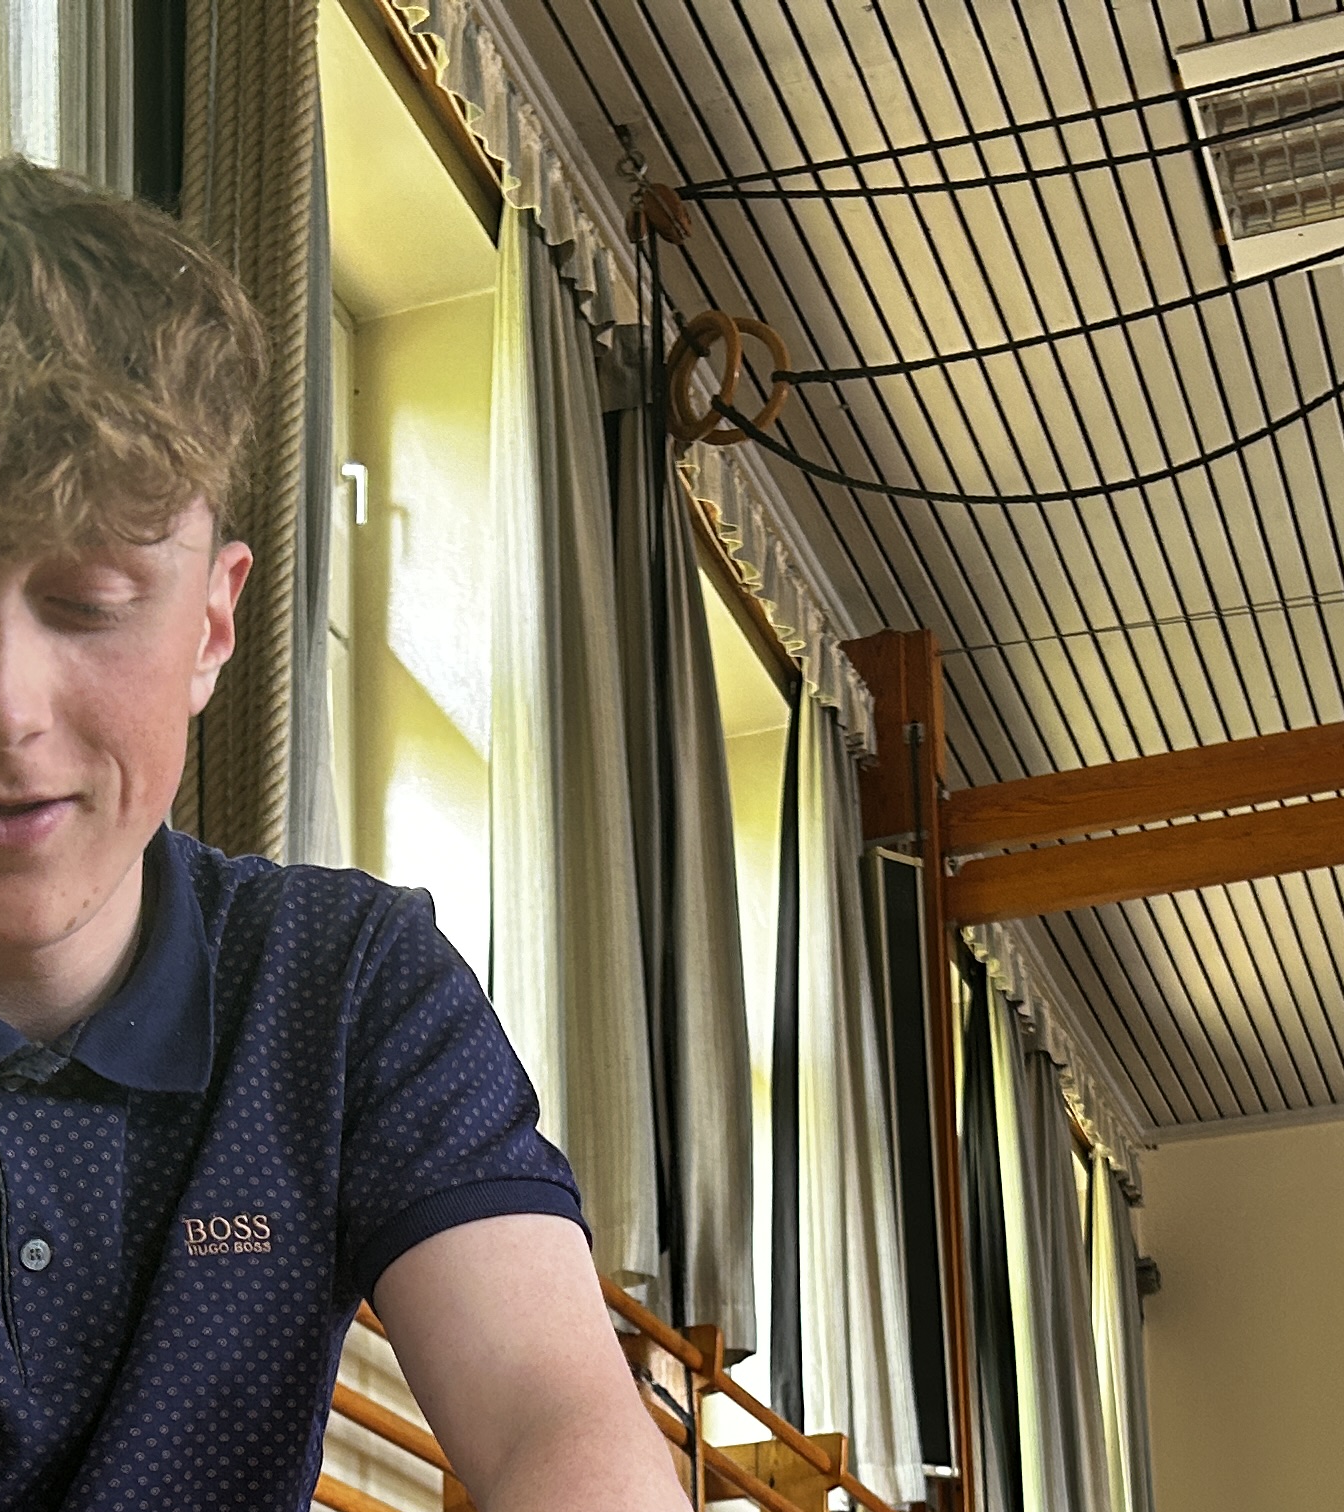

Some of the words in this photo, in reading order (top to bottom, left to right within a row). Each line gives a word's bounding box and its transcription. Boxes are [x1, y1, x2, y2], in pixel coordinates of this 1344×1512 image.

[184, 1214, 271, 1243] BOSS
[186, 1241, 230, 1256] HUGO
[233, 1241, 272, 1253] BOSS
